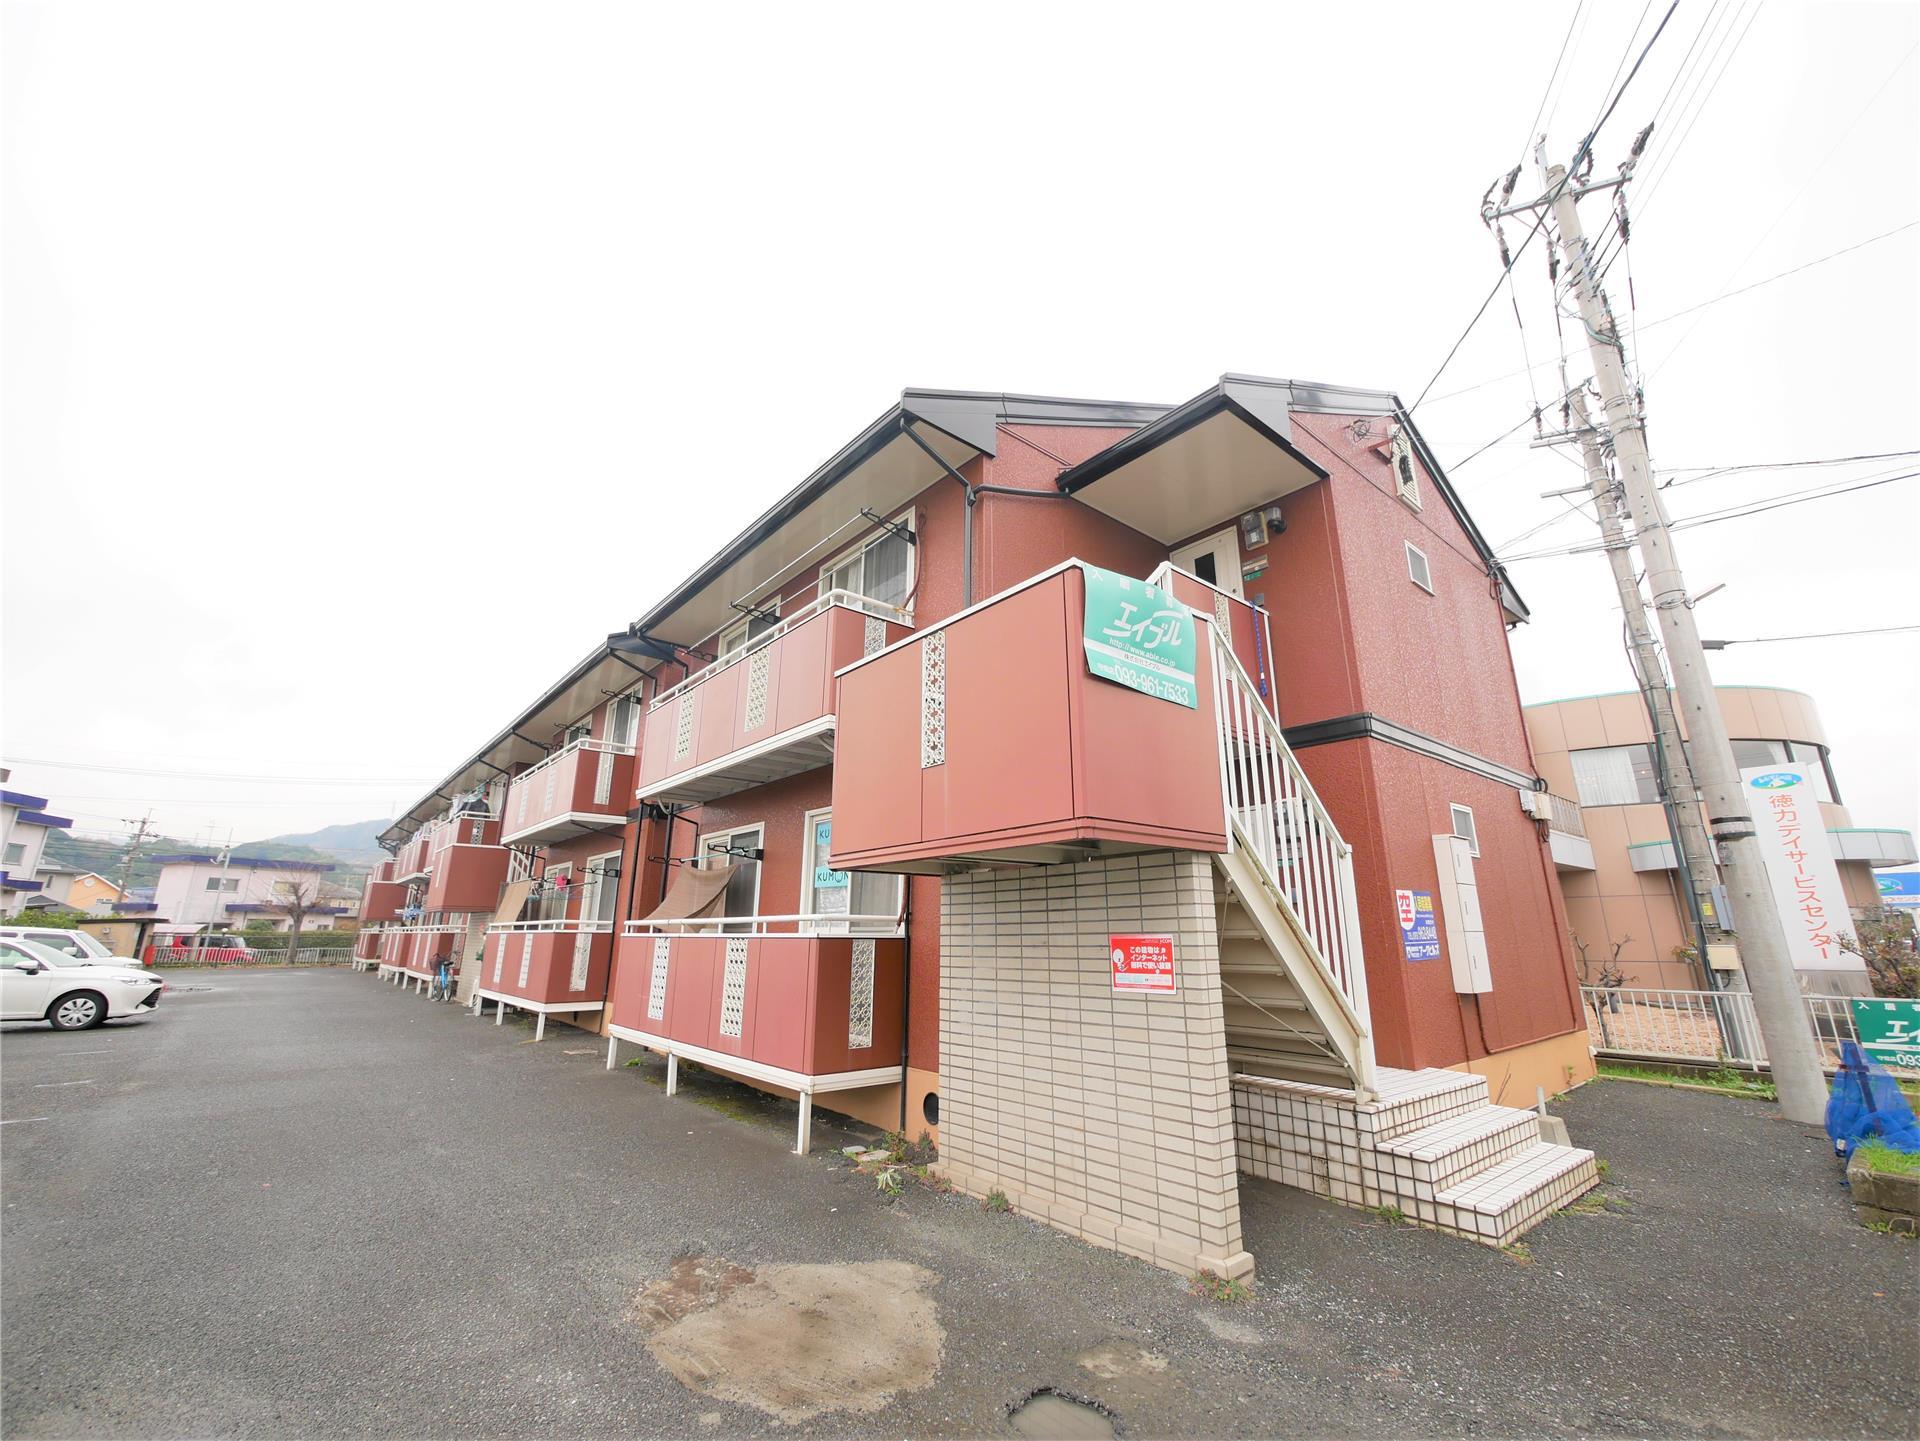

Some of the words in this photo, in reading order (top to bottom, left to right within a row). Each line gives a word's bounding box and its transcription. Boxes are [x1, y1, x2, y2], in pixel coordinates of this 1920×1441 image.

[1102, 602, 1183, 649] エイブル
[1114, 663, 1189, 705] 093-961-7533
[817, 872, 848, 882] KUMON
[1398, 893, 1413, 922] 空
